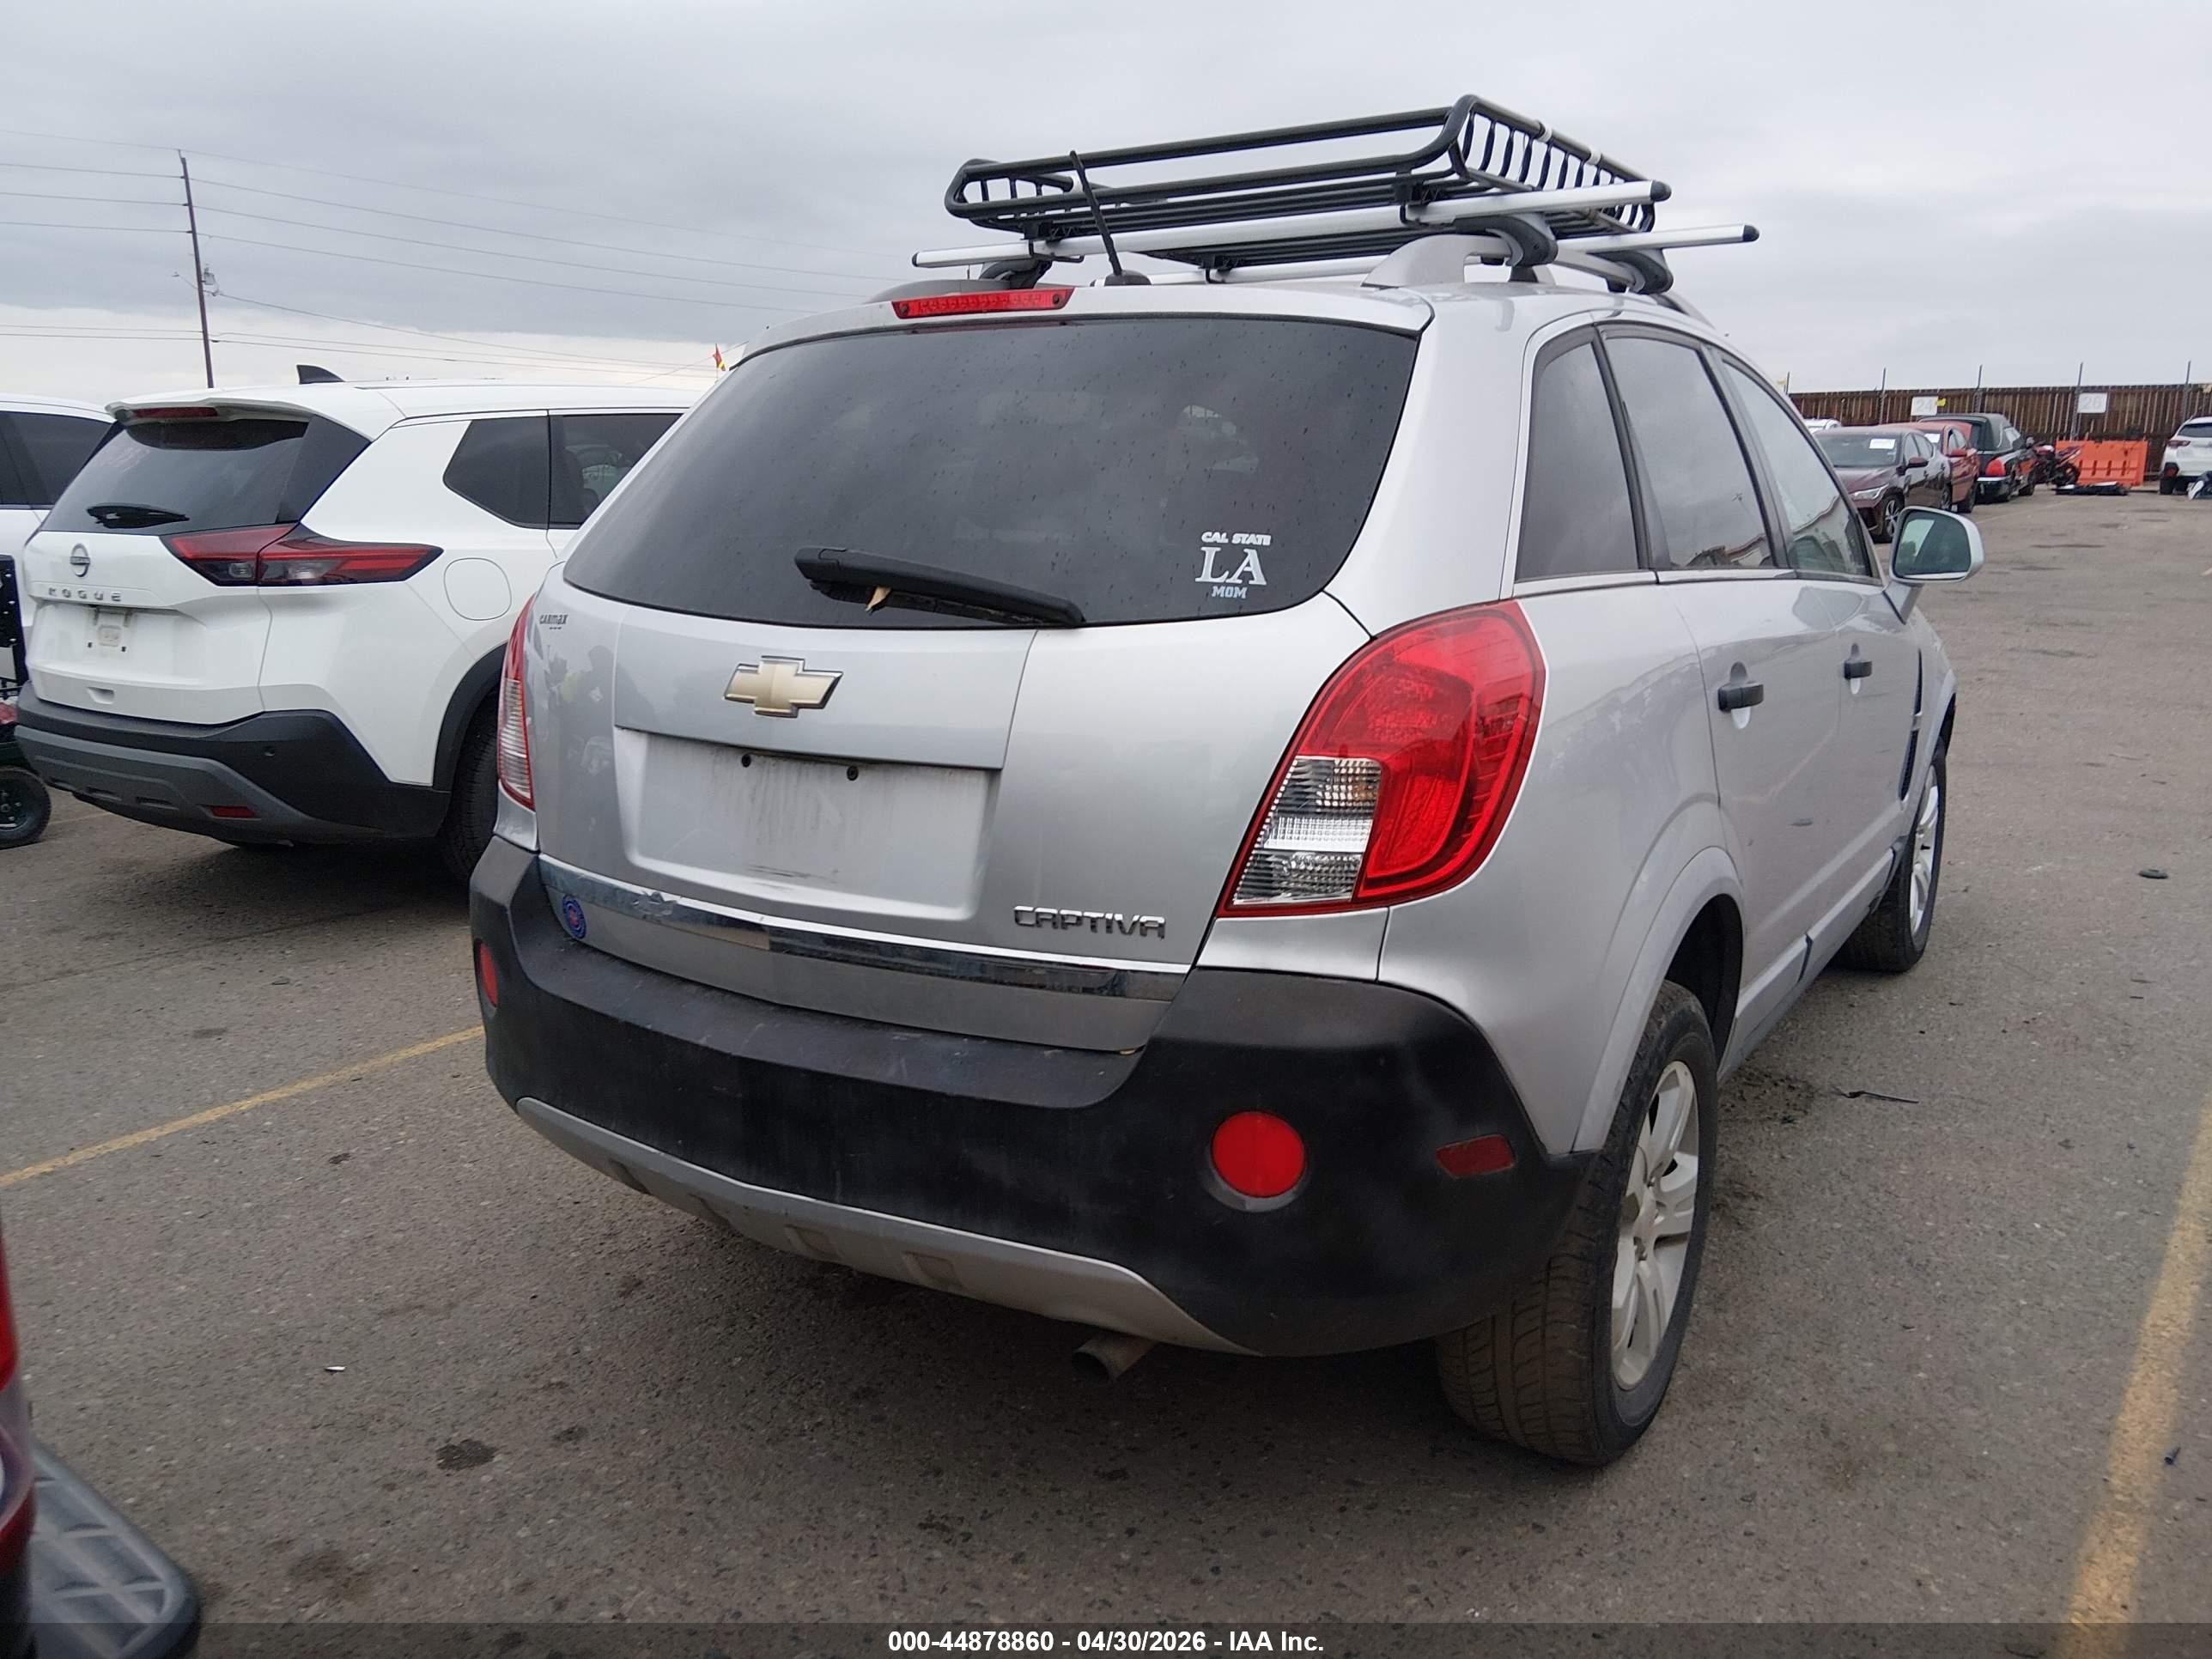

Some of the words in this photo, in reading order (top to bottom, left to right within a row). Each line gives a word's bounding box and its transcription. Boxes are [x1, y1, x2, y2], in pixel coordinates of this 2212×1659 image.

[1200, 531, 1229, 544] CAL
[1231, 532, 1272, 546] STATE
[1194, 546, 1267, 586] LA
[48, 586, 122, 602] ROGUE
[1211, 585, 1248, 599] MOM
[1013, 905, 1166, 939] CAPTIVA
